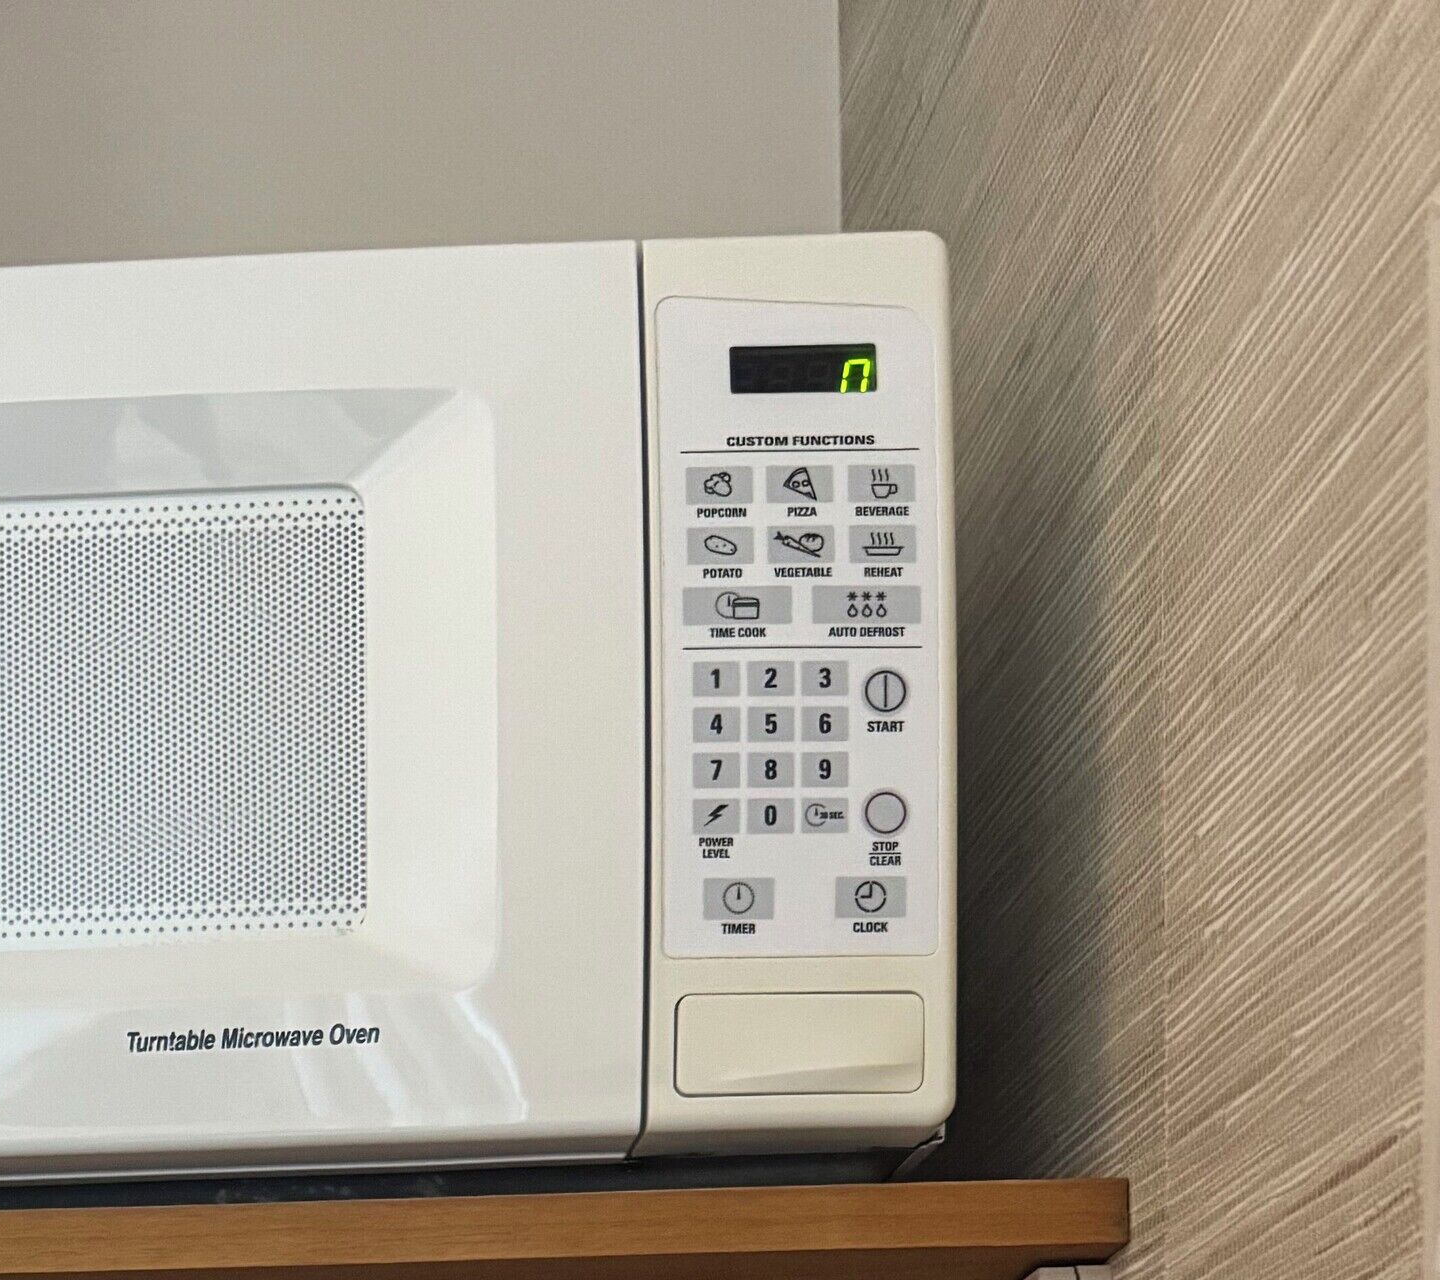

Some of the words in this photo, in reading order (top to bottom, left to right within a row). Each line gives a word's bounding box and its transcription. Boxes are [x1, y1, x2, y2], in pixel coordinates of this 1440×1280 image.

[726, 436, 788, 447] CUSTOM
[792, 435, 875, 446] FUNCTIONS
[697, 507, 747, 518] POPCORN
[787, 507, 817, 517] PIZZA
[855, 506, 909, 516] BEVERAGE
[702, 568, 742, 579] POTATO
[774, 567, 832, 578] VEGETABLE
[864, 567, 903, 577] REHEAT
[710, 627, 736, 638] TIME
[738, 627, 767, 638] COOK
[828, 627, 857, 637] AUTO
[859, 626, 905, 637] DEFROST
[710, 669, 721, 689] 1
[764, 668, 778, 689] 2
[819, 667, 832, 688] 3
[710, 714, 723, 735] 4
[765, 714, 777, 734] 5
[819, 713, 832, 734] 6
[867, 721, 905, 732] START
[710, 760, 723, 781] 7
[765, 759, 777, 780] 8
[819, 759, 832, 780] 9
[764, 805, 777, 826] 0
[699, 838, 733, 847] POWER
[872, 842, 898, 851] STOP
[702, 849, 730, 859] LEVEL
[869, 856, 901, 866] CLEAR
[721, 924, 756, 934] TIMER
[853, 922, 888, 933] CLOCK
[127, 1028, 215, 1053] Turntable
[221, 1026, 324, 1049] Microwave
[329, 1023, 380, 1045] Oven
